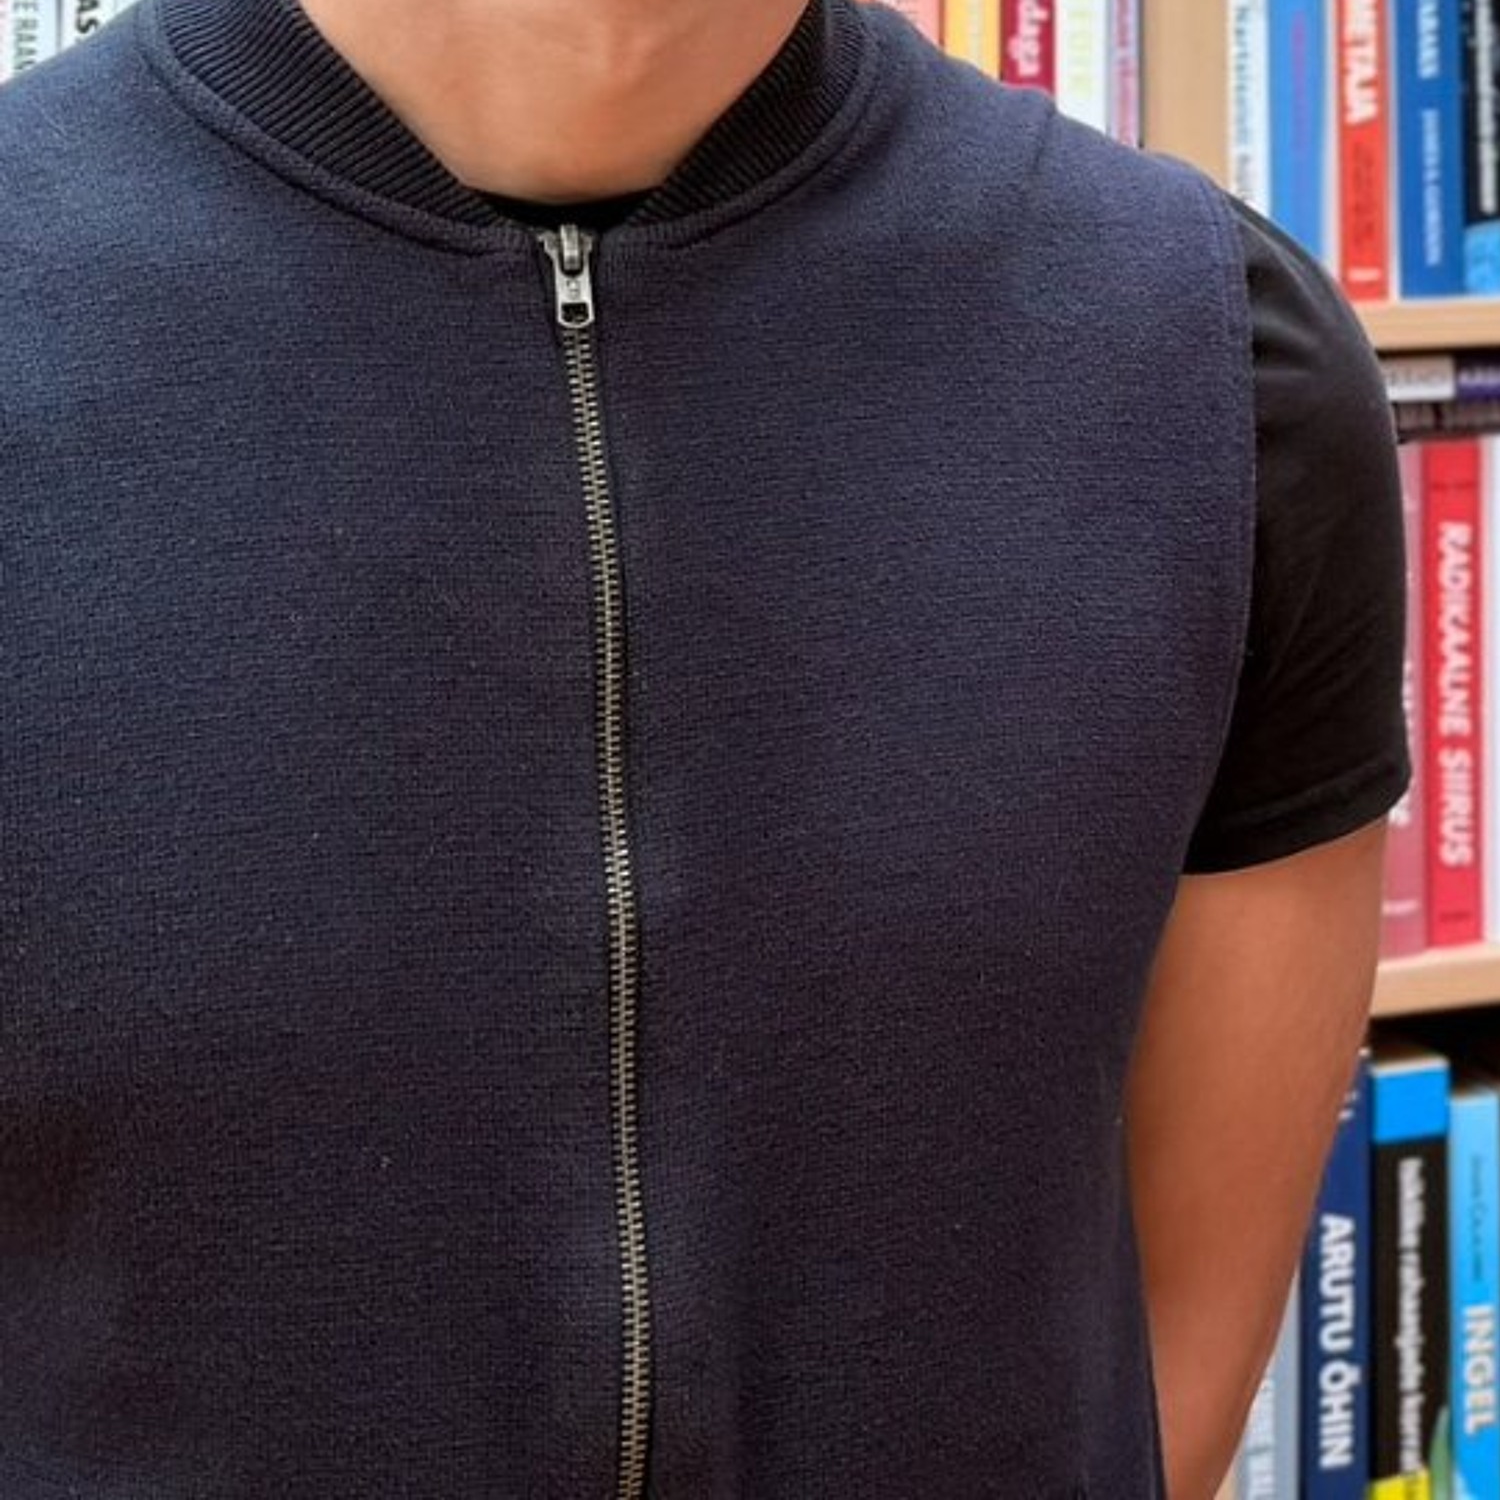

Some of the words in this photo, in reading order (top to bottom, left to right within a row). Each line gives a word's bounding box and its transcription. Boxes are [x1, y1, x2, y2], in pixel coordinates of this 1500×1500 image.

[1438, 521, 1476, 737] RADIKAALNE
[1438, 747, 1474, 868] SIIRUS
[1319, 1213, 1355, 1350] ARUTU
[1318, 1360, 1361, 1470] ÕHIN
[1463, 1303, 1496, 1435] INGEL
